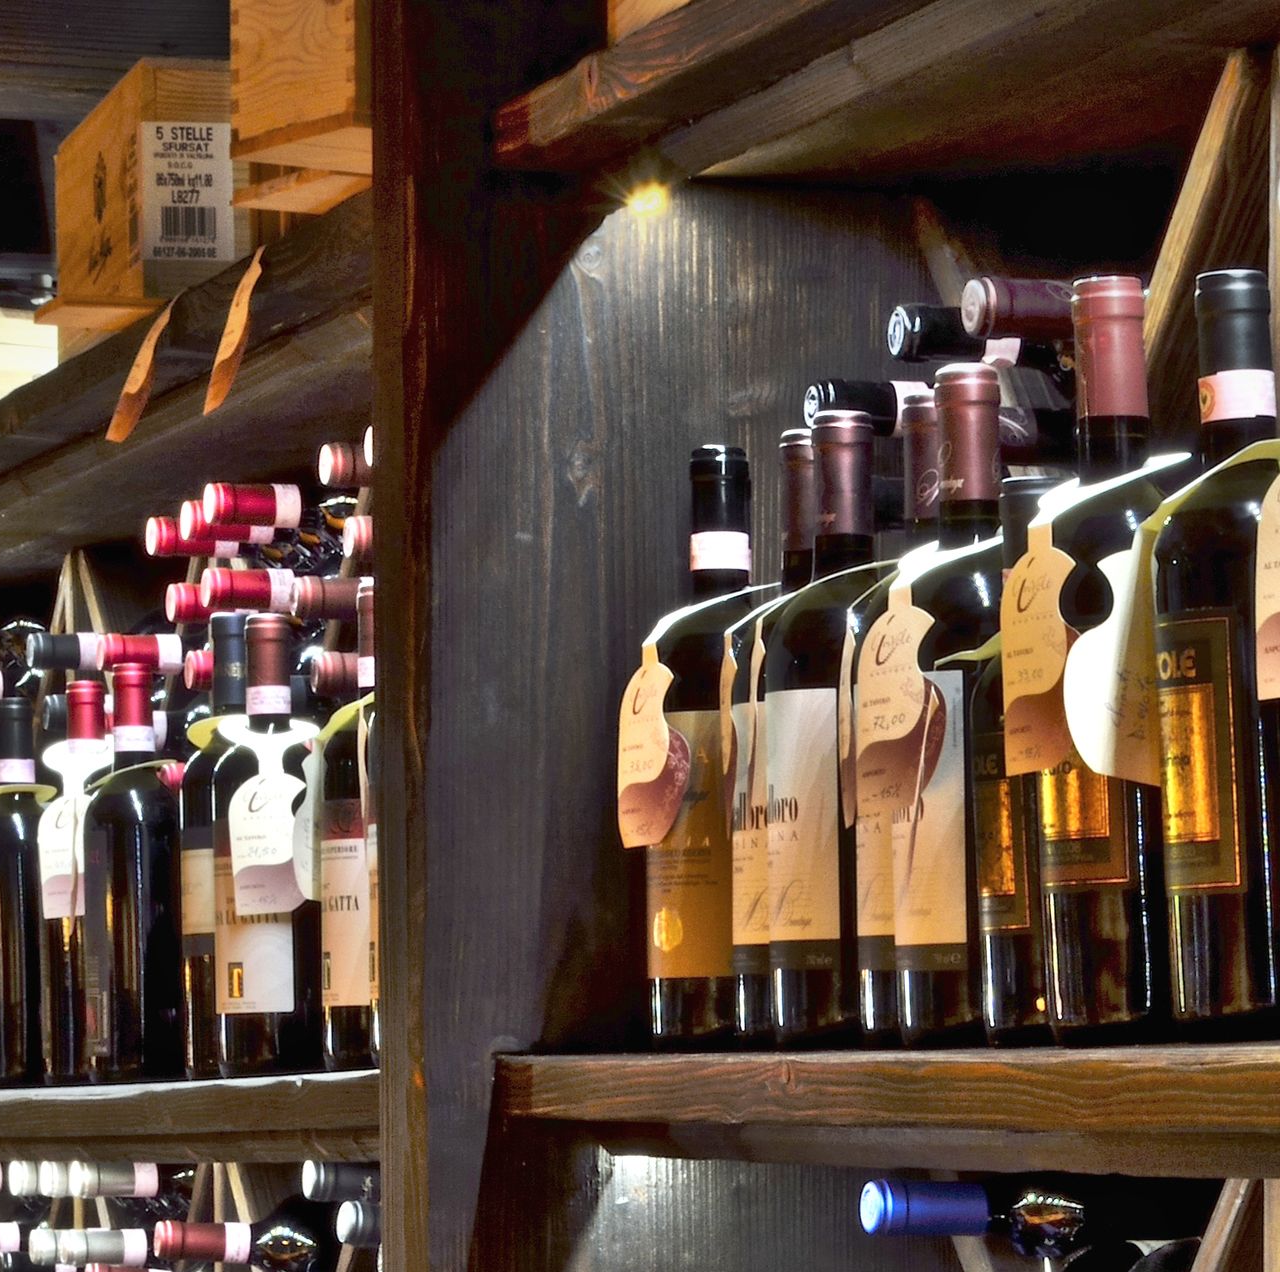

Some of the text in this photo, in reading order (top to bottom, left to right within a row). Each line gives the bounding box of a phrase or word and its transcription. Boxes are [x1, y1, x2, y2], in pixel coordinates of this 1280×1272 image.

[156, 126, 213, 141] 5 STELLE
[162, 142, 210, 152] SFURSAT
[328, 894, 360, 913] GATTA
